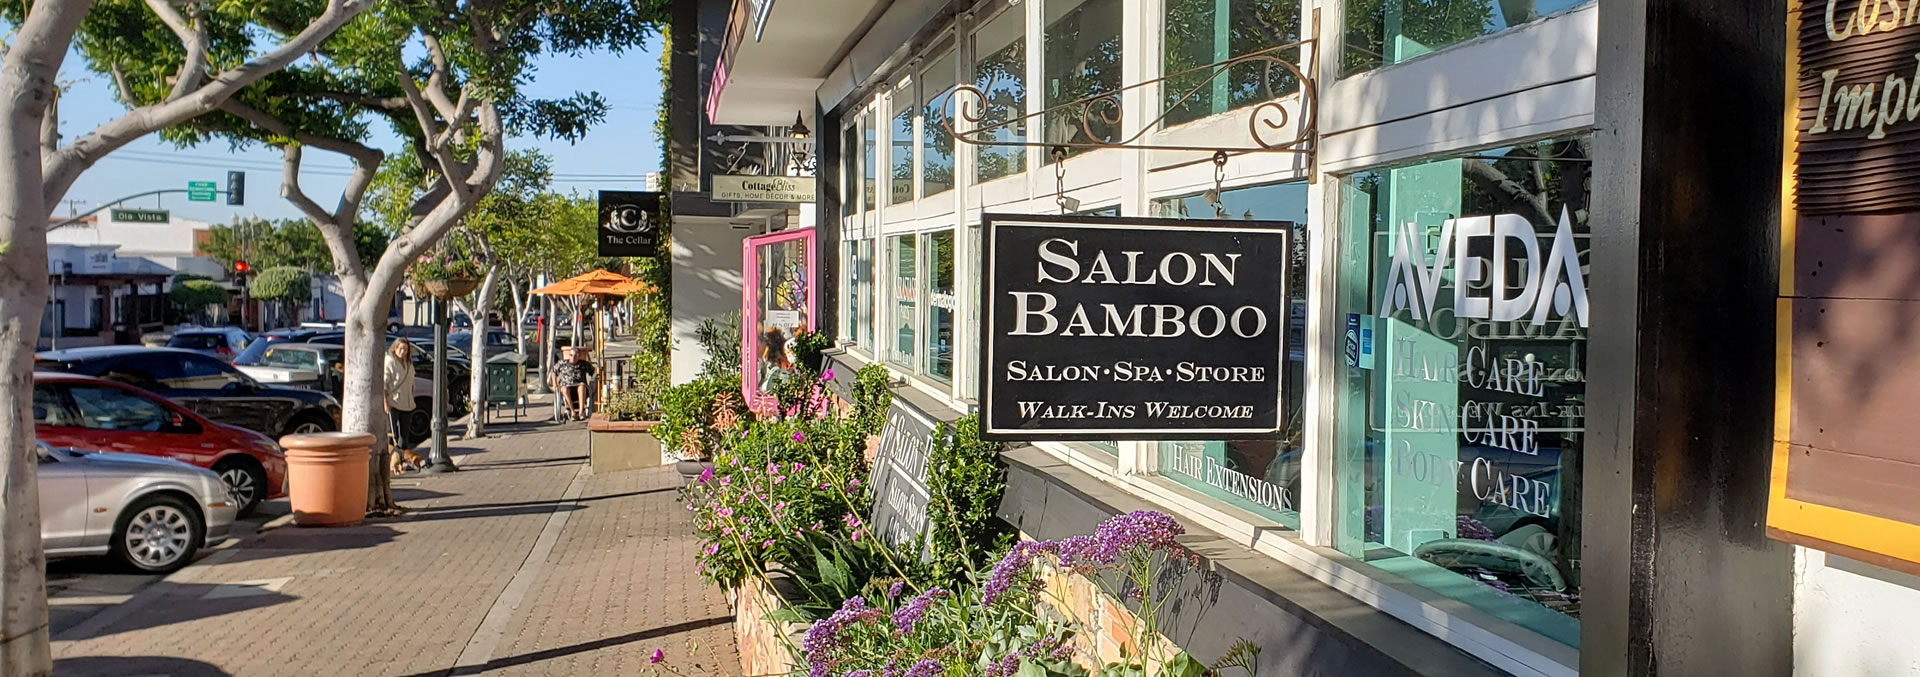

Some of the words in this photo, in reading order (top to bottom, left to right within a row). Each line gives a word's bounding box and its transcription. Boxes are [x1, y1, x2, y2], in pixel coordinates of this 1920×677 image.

[138, 213, 162, 221] Vista
[606, 235, 624, 245] The
[625, 235, 652, 245] Cellar
[1038, 238, 1242, 286] SALON
[1380, 203, 1589, 328] AVEDA
[1007, 291, 1267, 338] BAMBOO
[1396, 338, 1458, 384] HAIR
[1466, 345, 1544, 397] CARE
[1017, 401, 1136, 419] WALK-INS
[1144, 401, 1254, 419] WELCOME
[1394, 389, 1453, 436] SKIN
[1462, 400, 1538, 456] CARE
[890, 414, 924, 476] SALON
[1173, 444, 1202, 481] HAIR
[1206, 456, 1292, 512] EXTENSIONS
[1471, 456, 1550, 519] CARE
